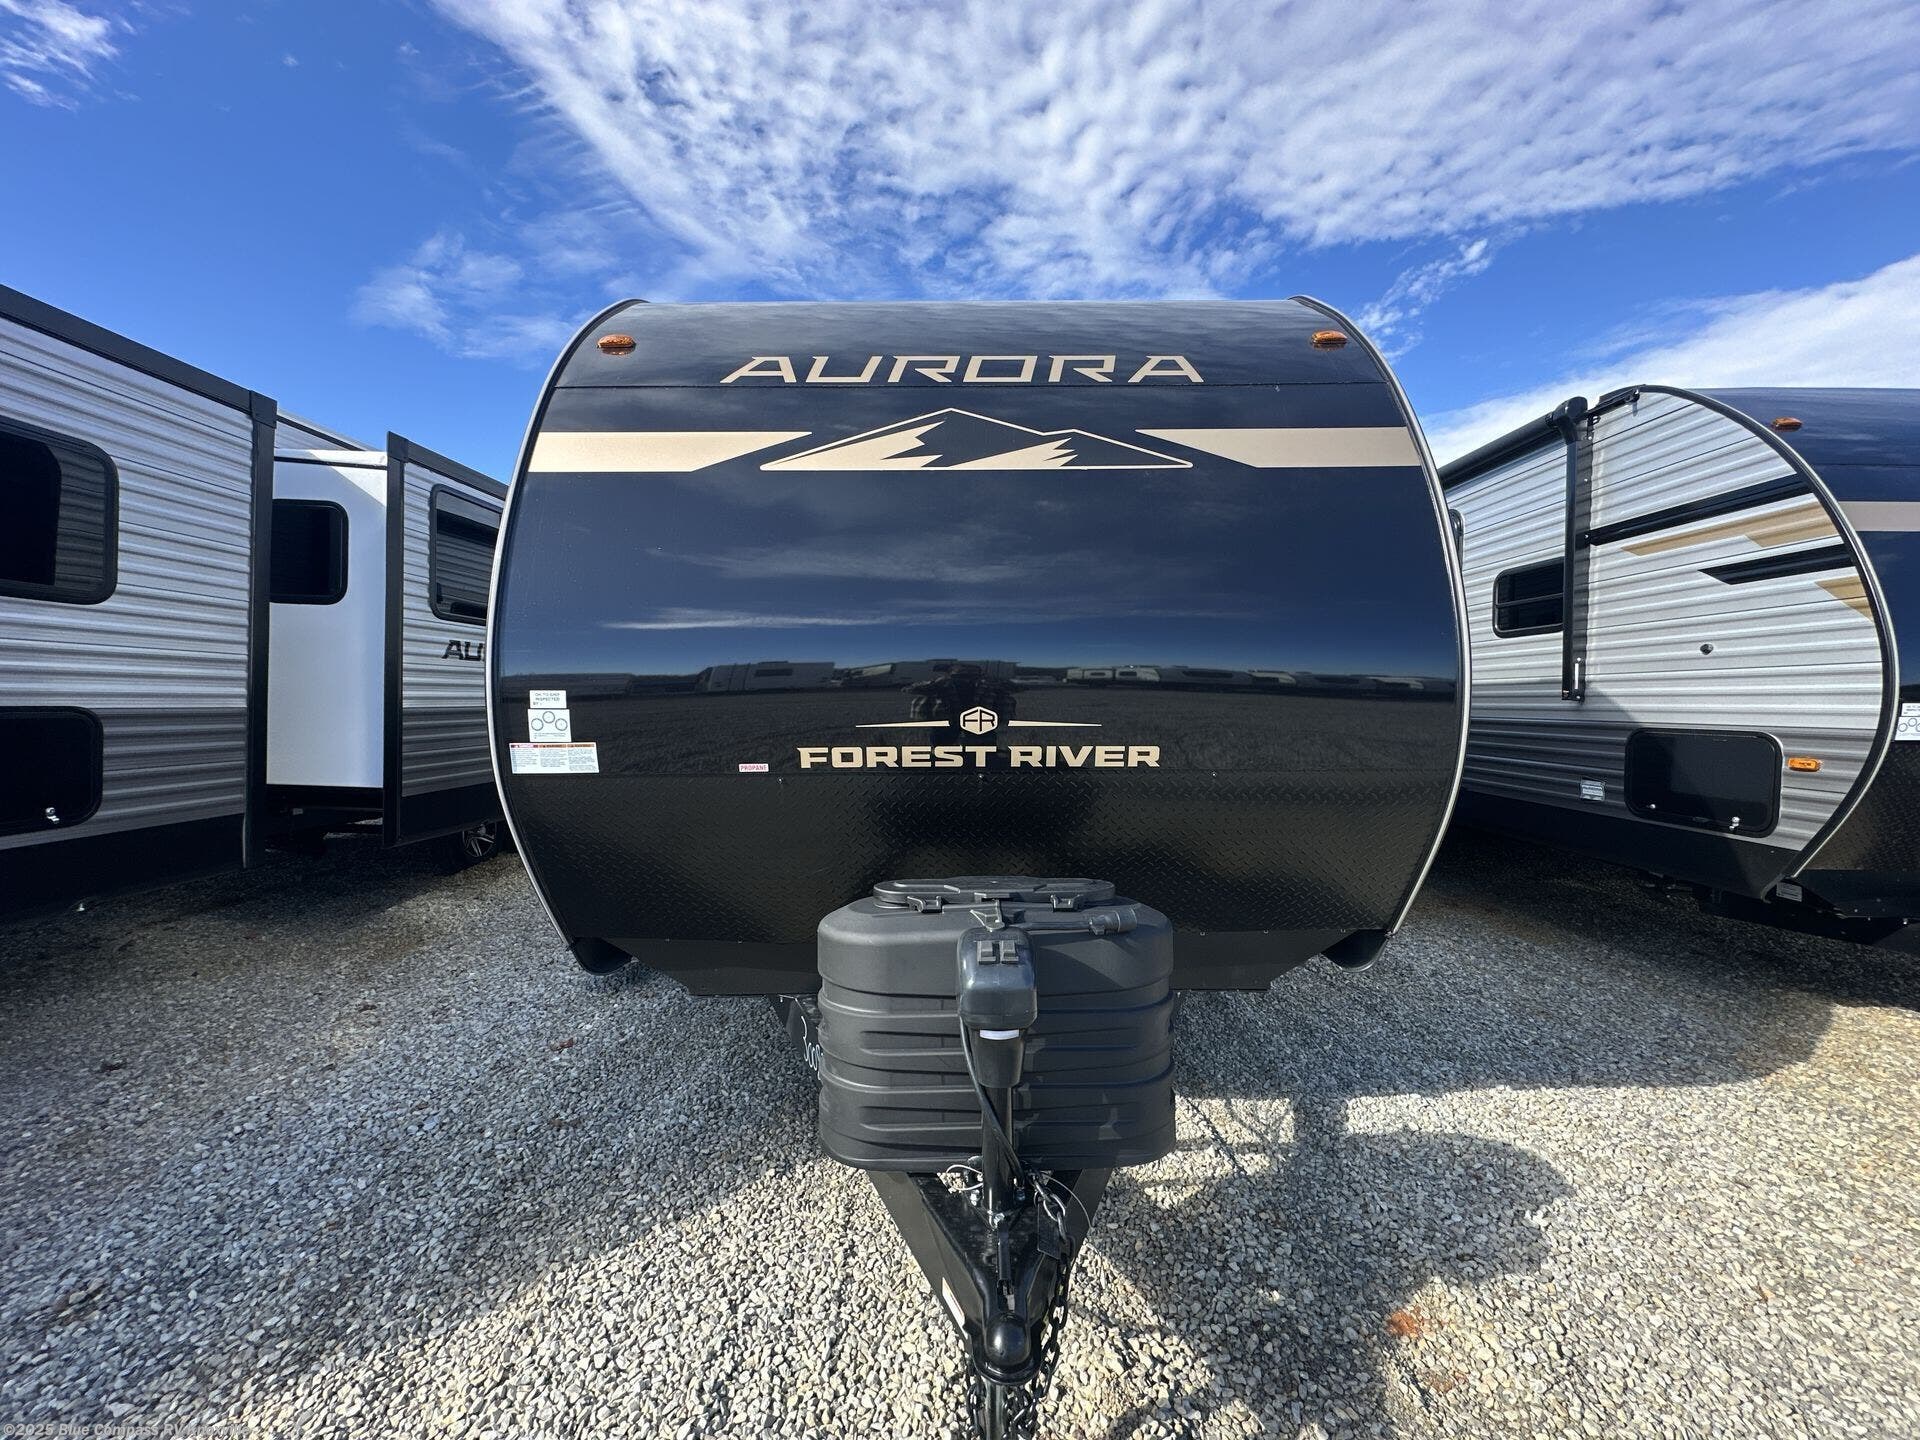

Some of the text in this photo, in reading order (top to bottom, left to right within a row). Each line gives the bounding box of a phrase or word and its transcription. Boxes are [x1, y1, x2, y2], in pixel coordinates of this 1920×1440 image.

[720, 355, 1204, 383] AURORA
[441, 639, 485, 662] AU
[797, 745, 1160, 768] FOREST RIVER
